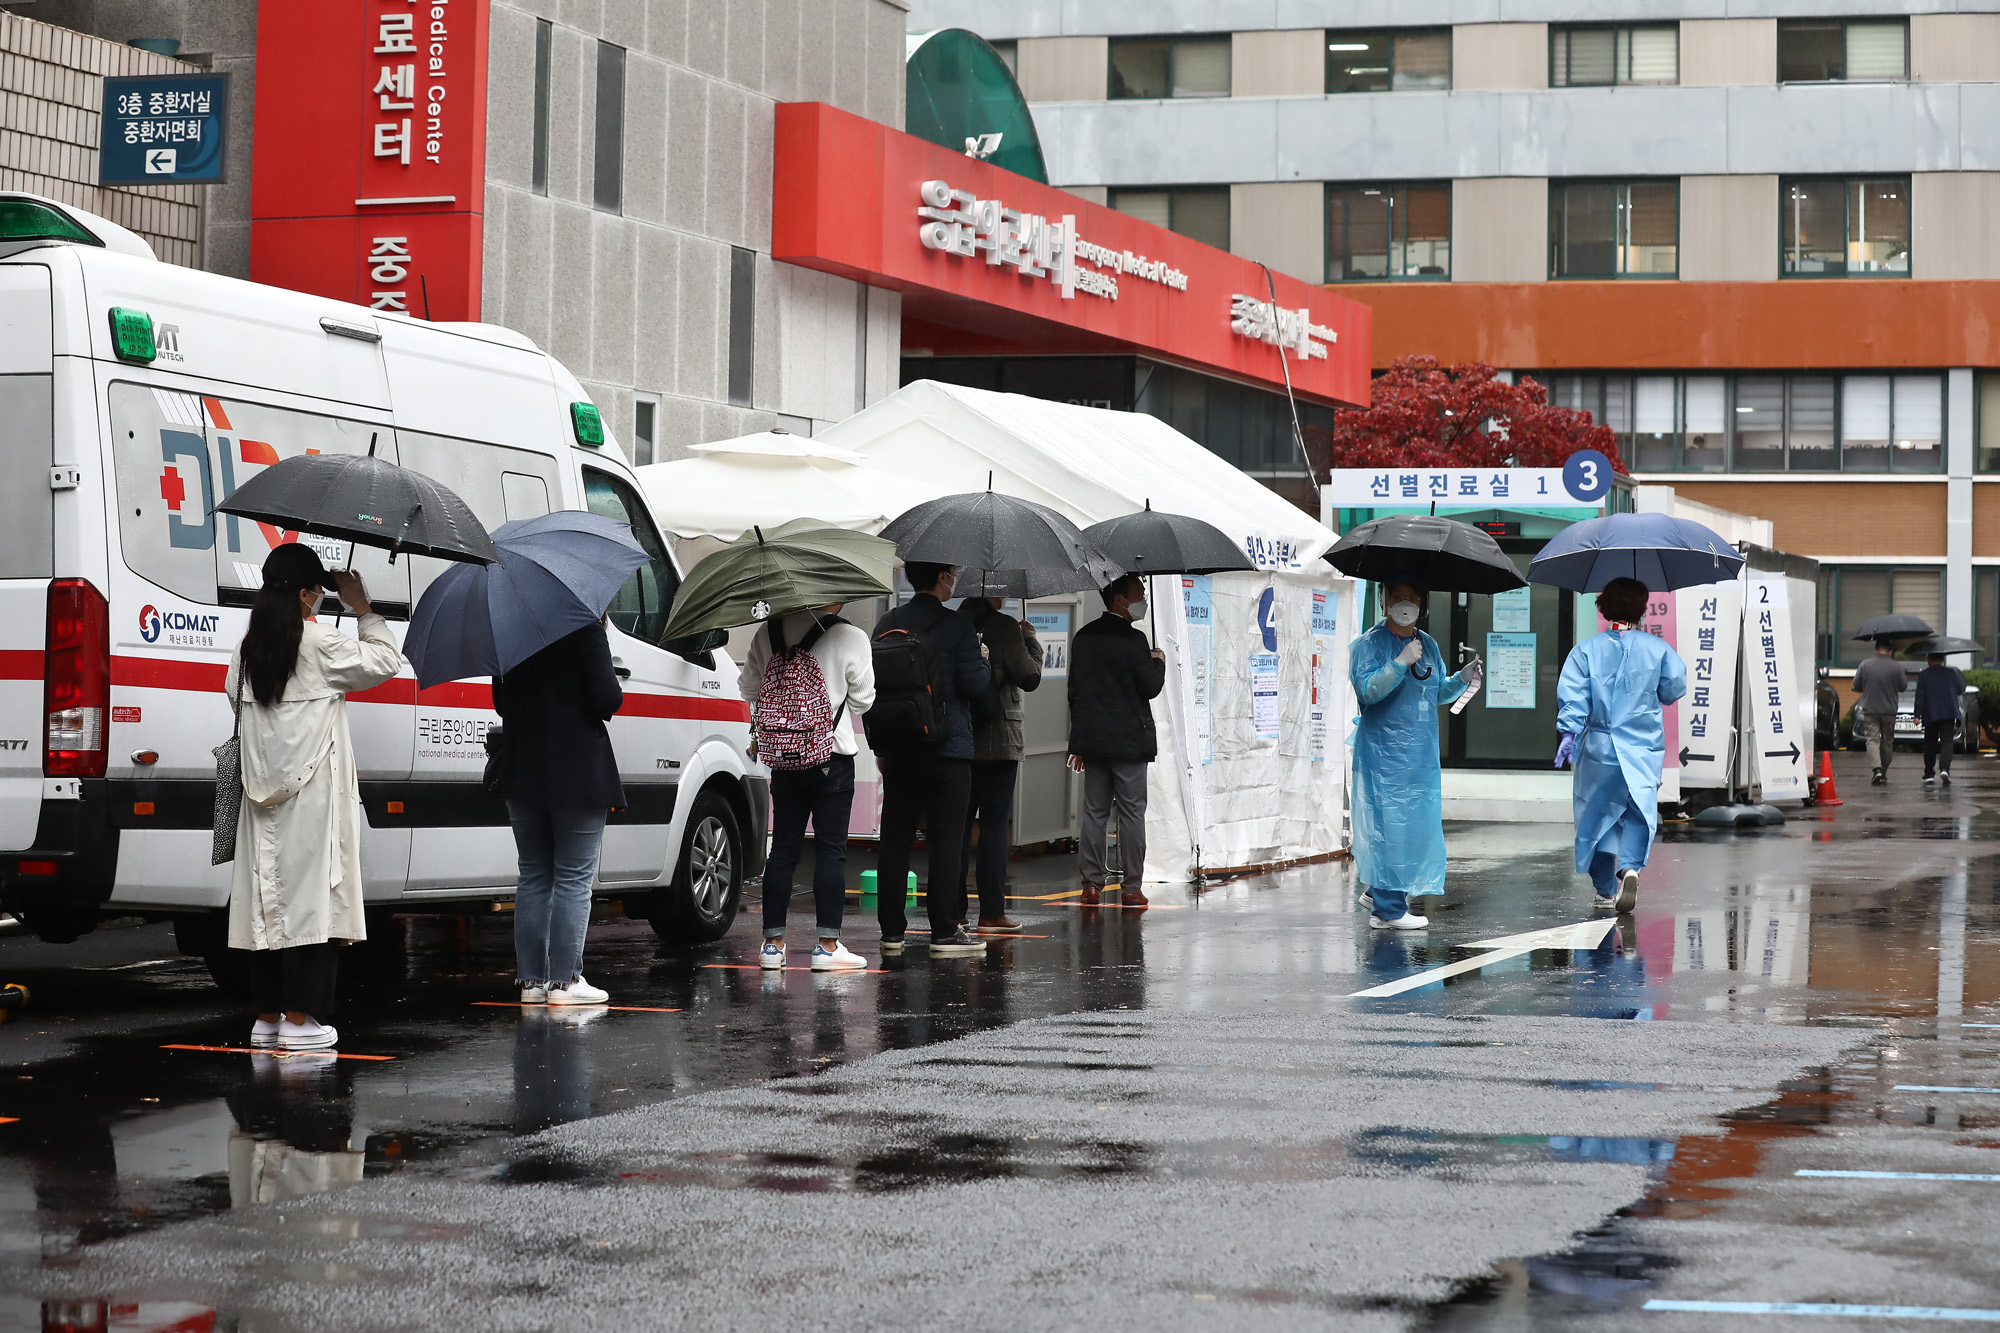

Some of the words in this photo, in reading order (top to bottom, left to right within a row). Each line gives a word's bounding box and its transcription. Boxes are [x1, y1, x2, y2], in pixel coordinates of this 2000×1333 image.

[372, 0, 417, 165] 료센터
[118, 93, 143, 115] 3층
[149, 90, 211, 115] 중환자실
[124, 119, 201, 144] 중환자면회
[426, 85, 446, 164] Center
[918, 180, 1065, 285] 응급의료센터
[1075, 234, 1123, 275] Emergency
[1123, 250, 1159, 282] Medical
[1159, 261, 1188, 291] Center
[1370, 473, 1509, 498] 선별진료실
[1536, 476, 1548, 495] 1
[1578, 460, 1599, 492] 3
[308, 544, 341, 561] HICLE
[1758, 585, 1769, 604] 2
[1646, 602, 1669, 617] 19
[163, 612, 220, 633] KDMAT
[1689, 597, 1718, 738] 선별진료실
[1759, 610, 1784, 734] 선별진료실
[701, 681, 721, 690] AUTECH
[418, 749, 443, 758] national
[443, 749, 466, 758] medical
[467, 751, 485, 759] center
